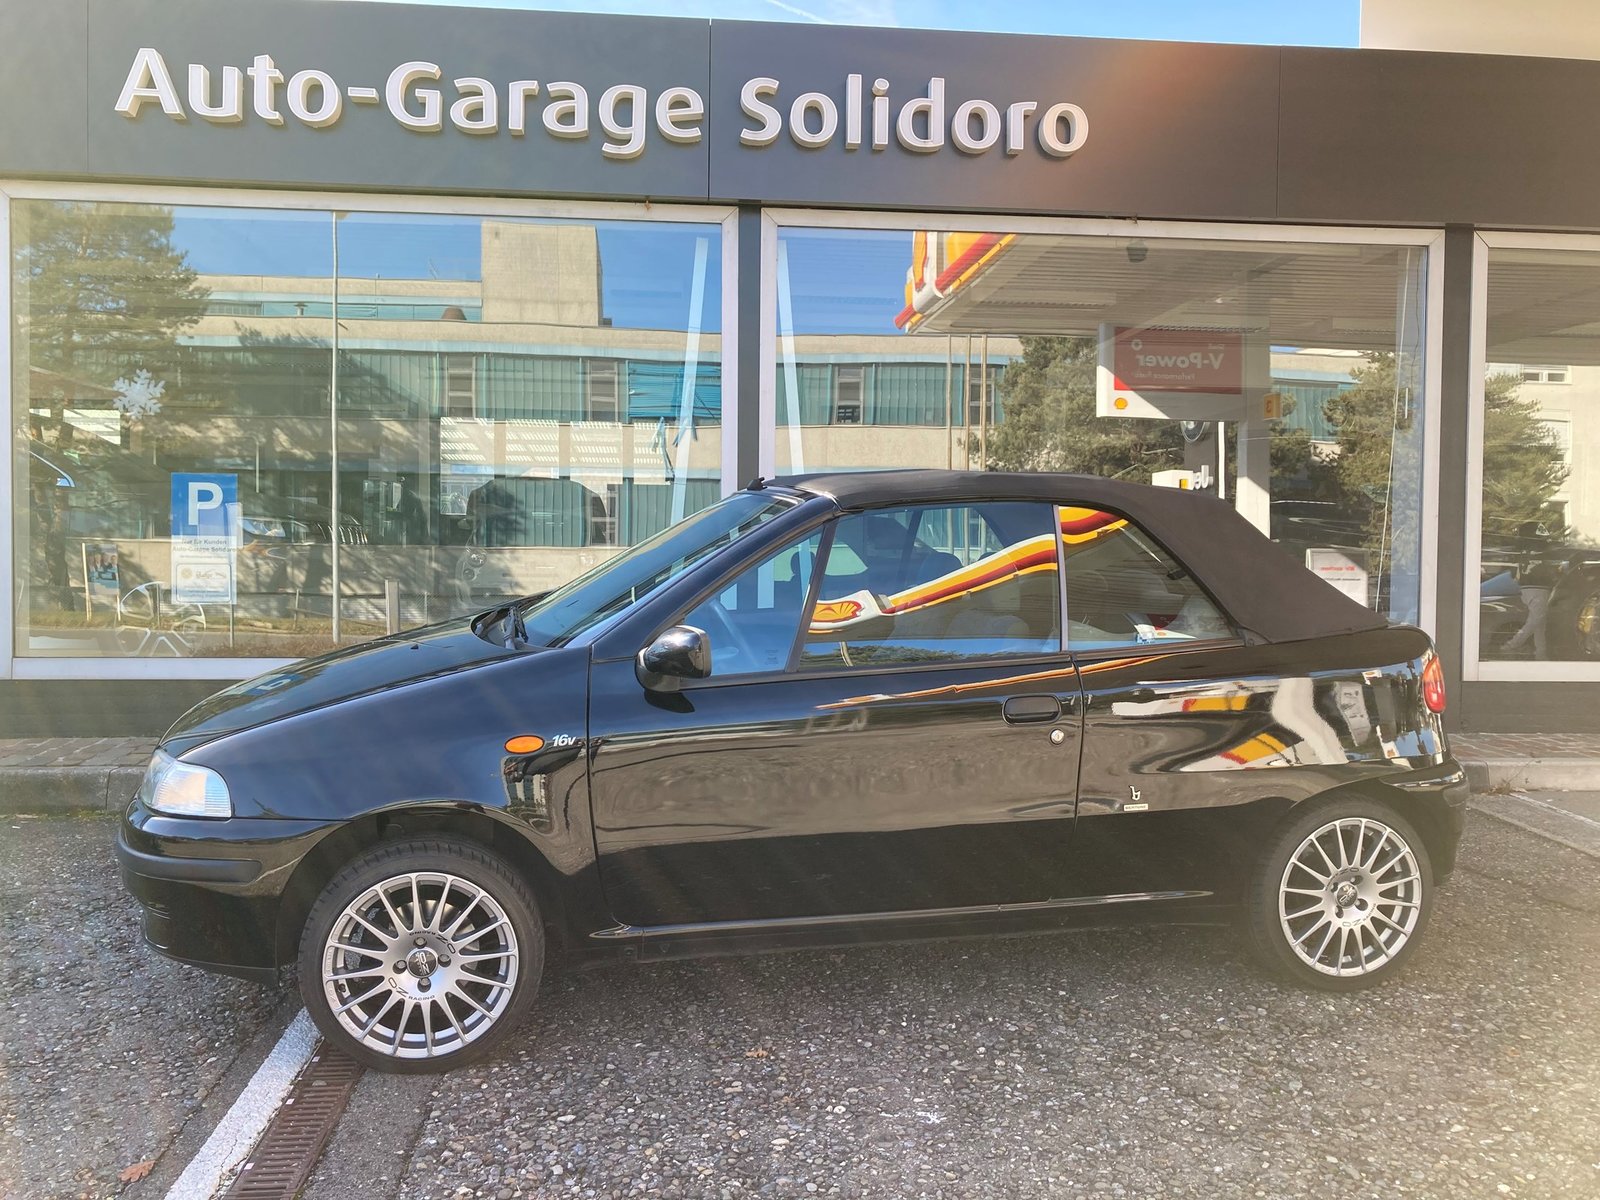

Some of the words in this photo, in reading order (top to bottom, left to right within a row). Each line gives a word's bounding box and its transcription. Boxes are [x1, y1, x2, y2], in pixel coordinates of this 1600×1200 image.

[114, 47, 705, 160] Auto-Garage
[738, 73, 1089, 158] Solidoro
[187, 482, 224, 526] P
[552, 734, 576, 747] 16v
